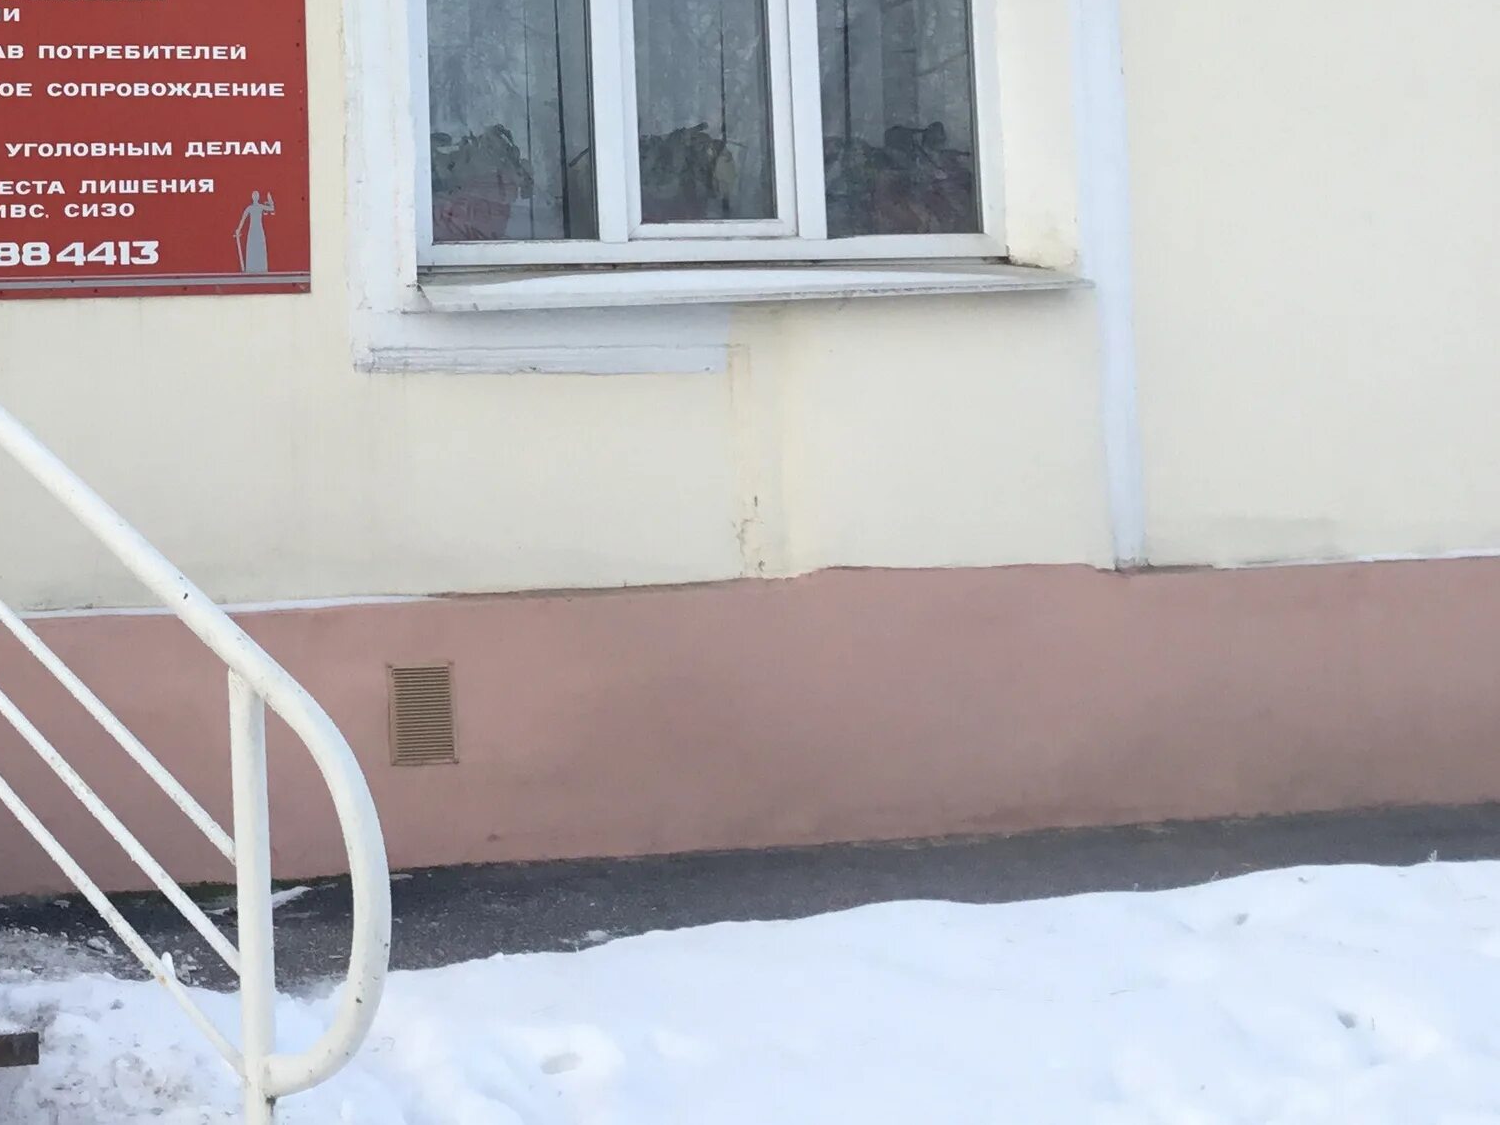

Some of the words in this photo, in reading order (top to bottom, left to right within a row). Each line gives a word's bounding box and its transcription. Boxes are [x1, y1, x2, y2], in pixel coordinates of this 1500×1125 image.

[39, 45, 246, 59] ПОТРЕБИТЕЛЕЙ
[47, 83, 284, 98] СОПРОВОЖДЕНИЕ
[5, 142, 172, 157] УГОЛОВНЫМ
[185, 141, 281, 157] ДЕЛАМ
[80, 179, 213, 193] ЛИШЕНИЯ
[65, 203, 134, 217] СИЗО
[56, 241, 158, 266] 4413
